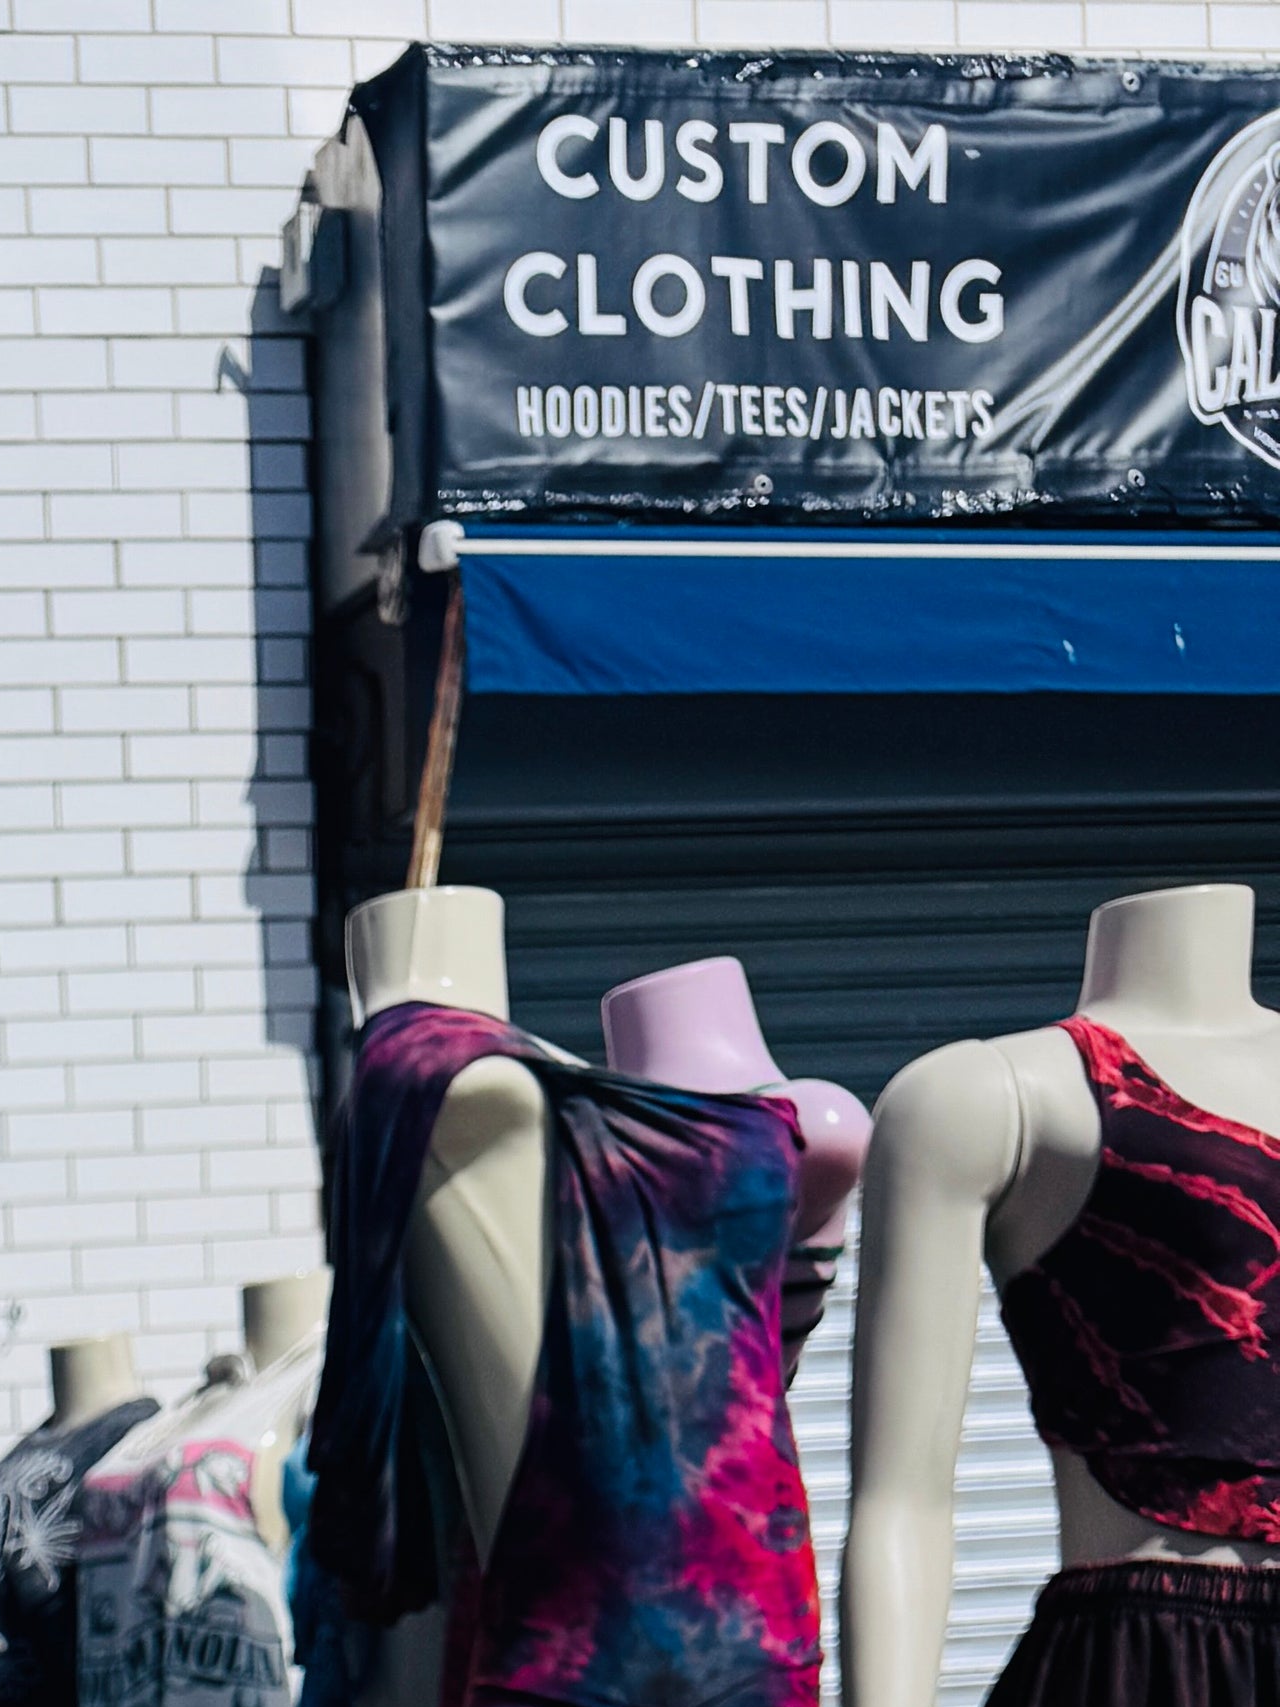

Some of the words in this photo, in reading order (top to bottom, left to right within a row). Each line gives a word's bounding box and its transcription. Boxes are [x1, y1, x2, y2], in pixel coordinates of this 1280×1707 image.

[536, 114, 948, 206] CUSTOM
[503, 253, 1006, 342] CLOTHING
[517, 382, 994, 440] HOODIES/TEES/JACKETS
